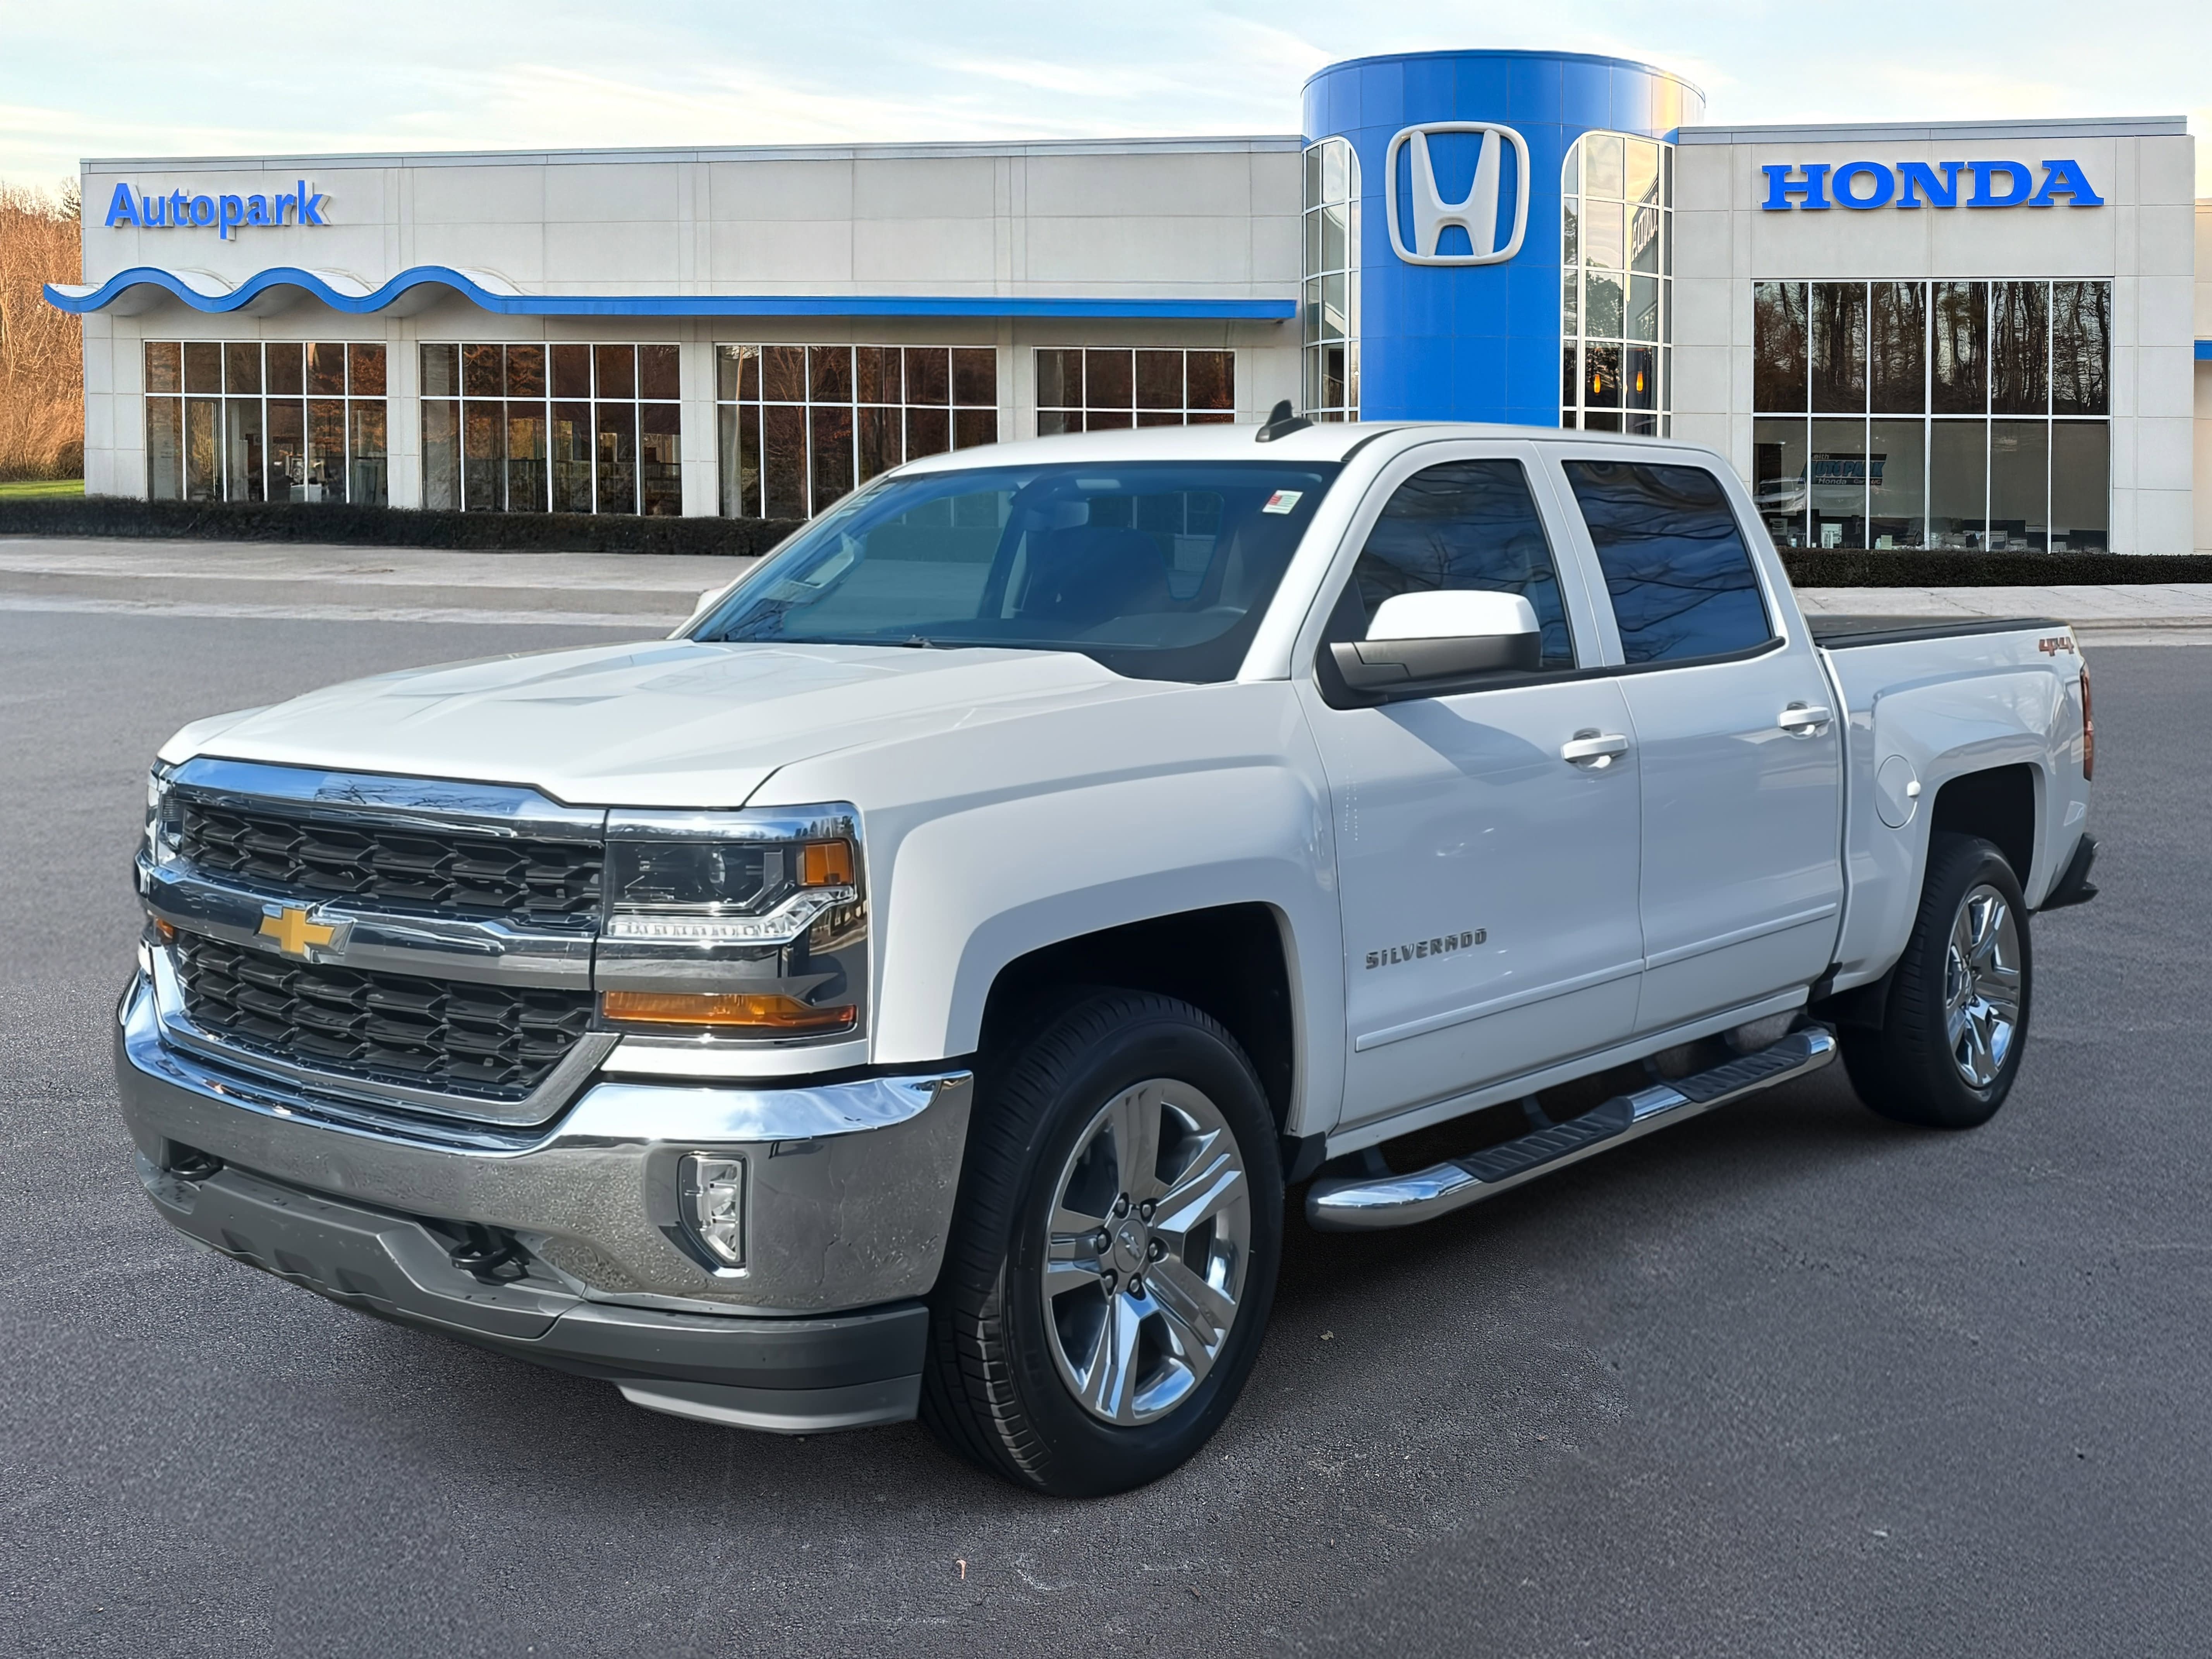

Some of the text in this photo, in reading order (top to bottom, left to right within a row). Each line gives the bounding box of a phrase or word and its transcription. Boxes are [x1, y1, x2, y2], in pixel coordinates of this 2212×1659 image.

[1761, 160, 2104, 210] HONDA
[105, 180, 331, 241] Autopark
[1366, 927, 1487, 969] SILVERADO
